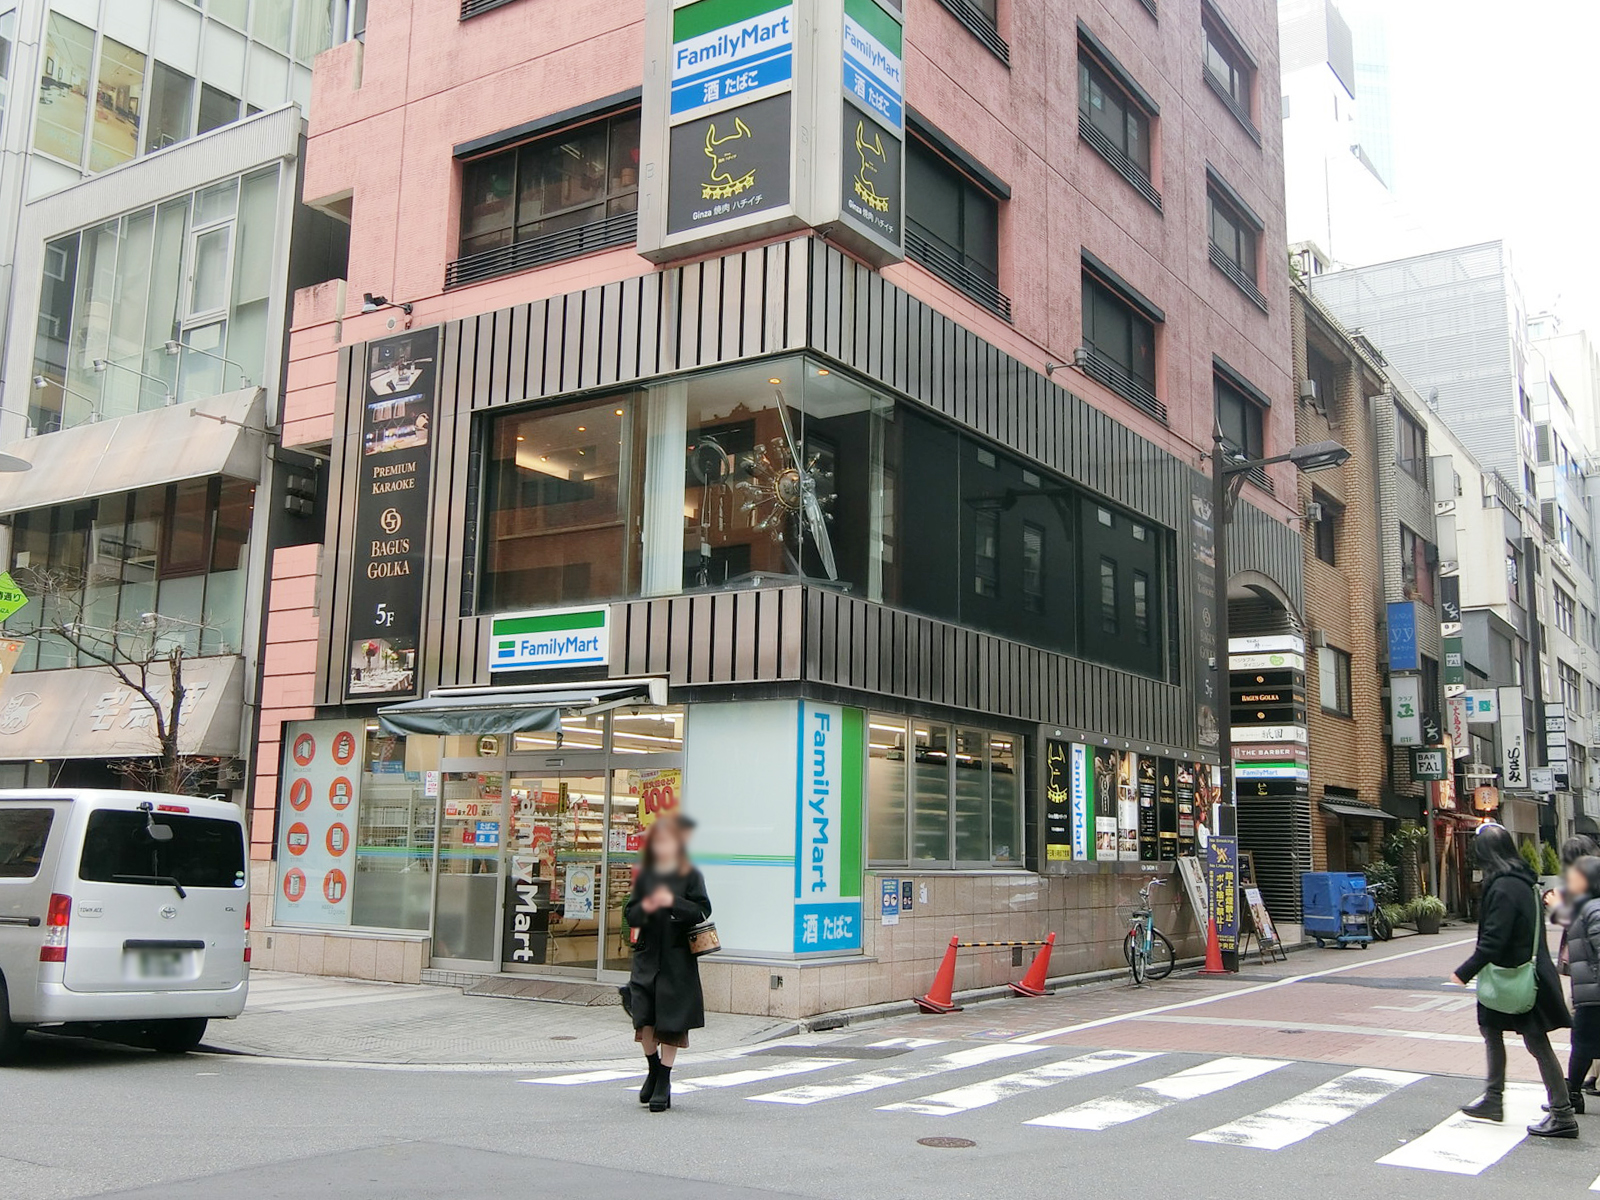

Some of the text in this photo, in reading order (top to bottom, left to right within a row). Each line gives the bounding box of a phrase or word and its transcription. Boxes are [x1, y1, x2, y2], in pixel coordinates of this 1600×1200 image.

[677, 16, 789, 69] FamilyMart
[845, 24, 900, 82] FamilyMart
[703, 70, 759, 103] 酒 たばこ
[854, 76, 890, 117] 酒 たばこ
[692, 193, 763, 220] Ginza 焼肉 ハチイチ
[848, 199, 862, 215] Ginza
[372, 461, 416, 478] PREMIUM
[371, 478, 416, 495] KARAOKE
[371, 538, 410, 558] BAGUS
[367, 560, 410, 579] GOLKA
[375, 603, 394, 627] 5F
[521, 635, 599, 657] FamilyMart
[1242, 769, 1278, 777] FamilyMart
[1418, 761, 1440, 772] FAL
[466, 803, 478, 816] 20
[641, 786, 674, 815] 100
[809, 712, 830, 893] FamilyMart
[1074, 749, 1086, 858] FamilyMart
[479, 822, 496, 830] たばこ
[512, 780, 542, 962] FamilyMart
[803, 913, 853, 944] 酒 たばこ
